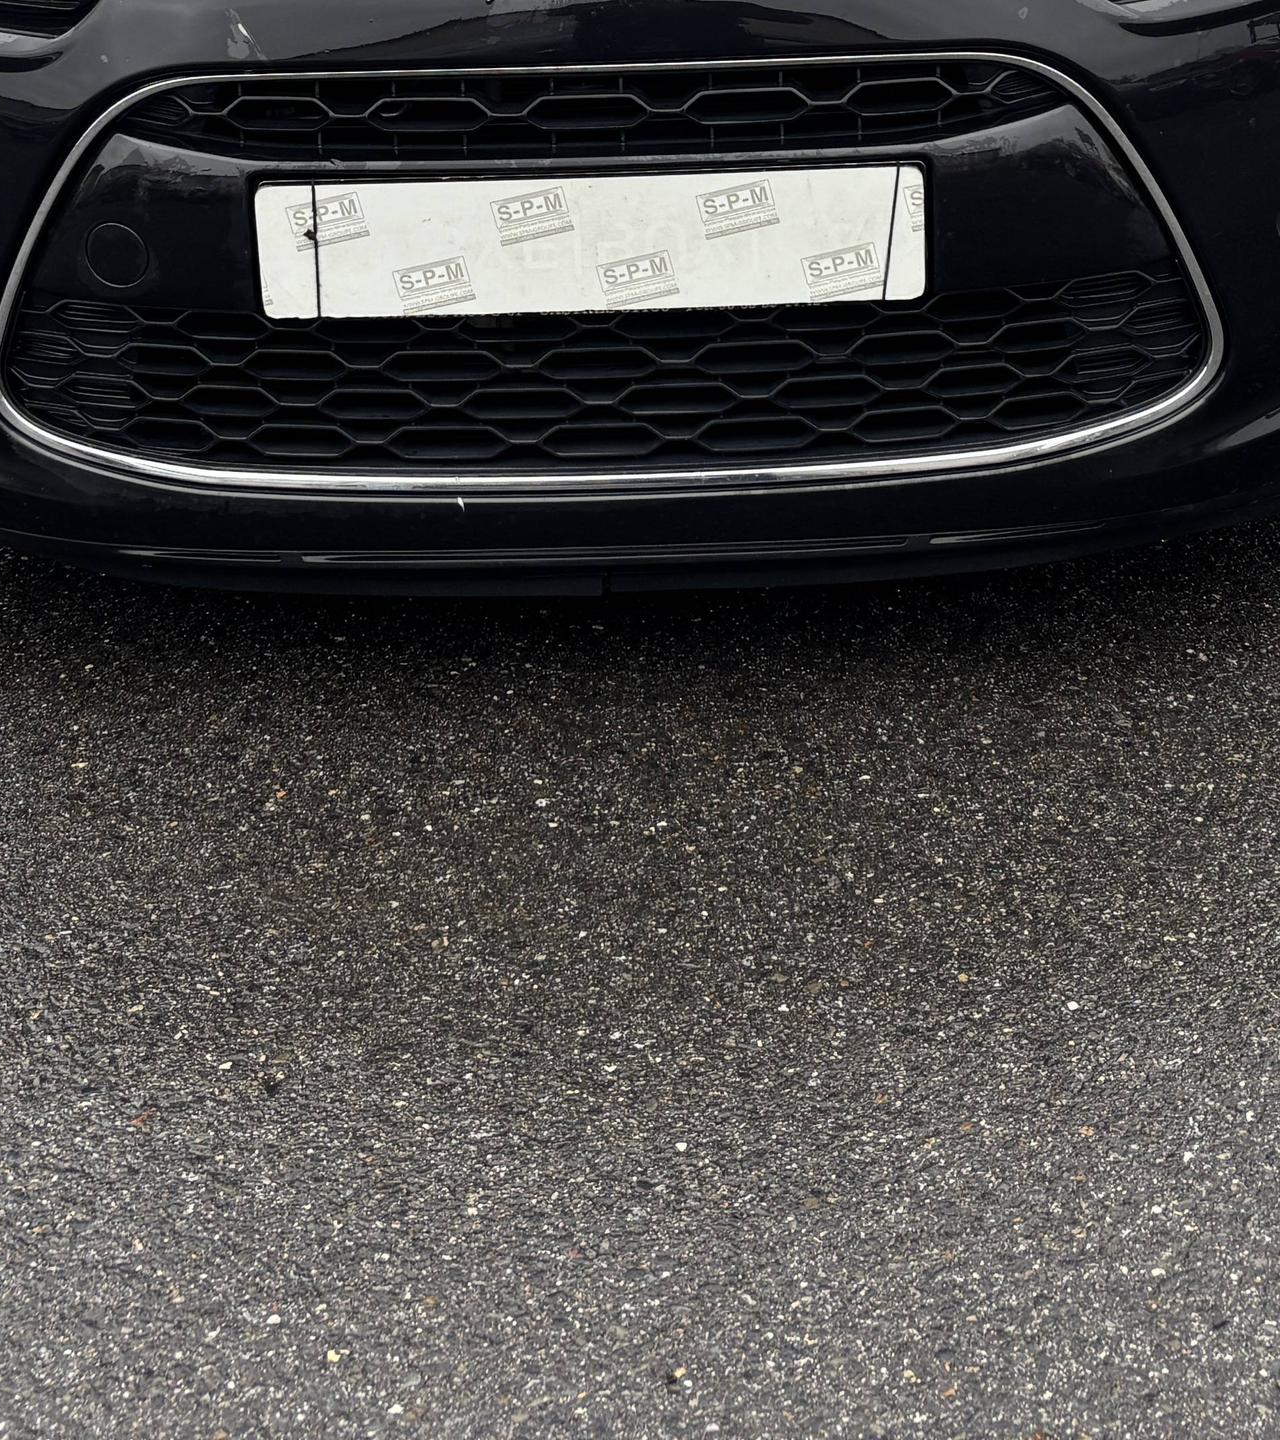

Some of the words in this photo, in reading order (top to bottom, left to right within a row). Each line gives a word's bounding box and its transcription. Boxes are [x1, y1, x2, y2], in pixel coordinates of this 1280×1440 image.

[292, 198, 358, 227] S-P-M
[497, 192, 563, 221] S-P-M
[702, 186, 769, 216] S-P-M
[399, 262, 465, 291] S-P-M
[602, 256, 669, 285] S-P-M
[808, 248, 874, 278] S-P-M
